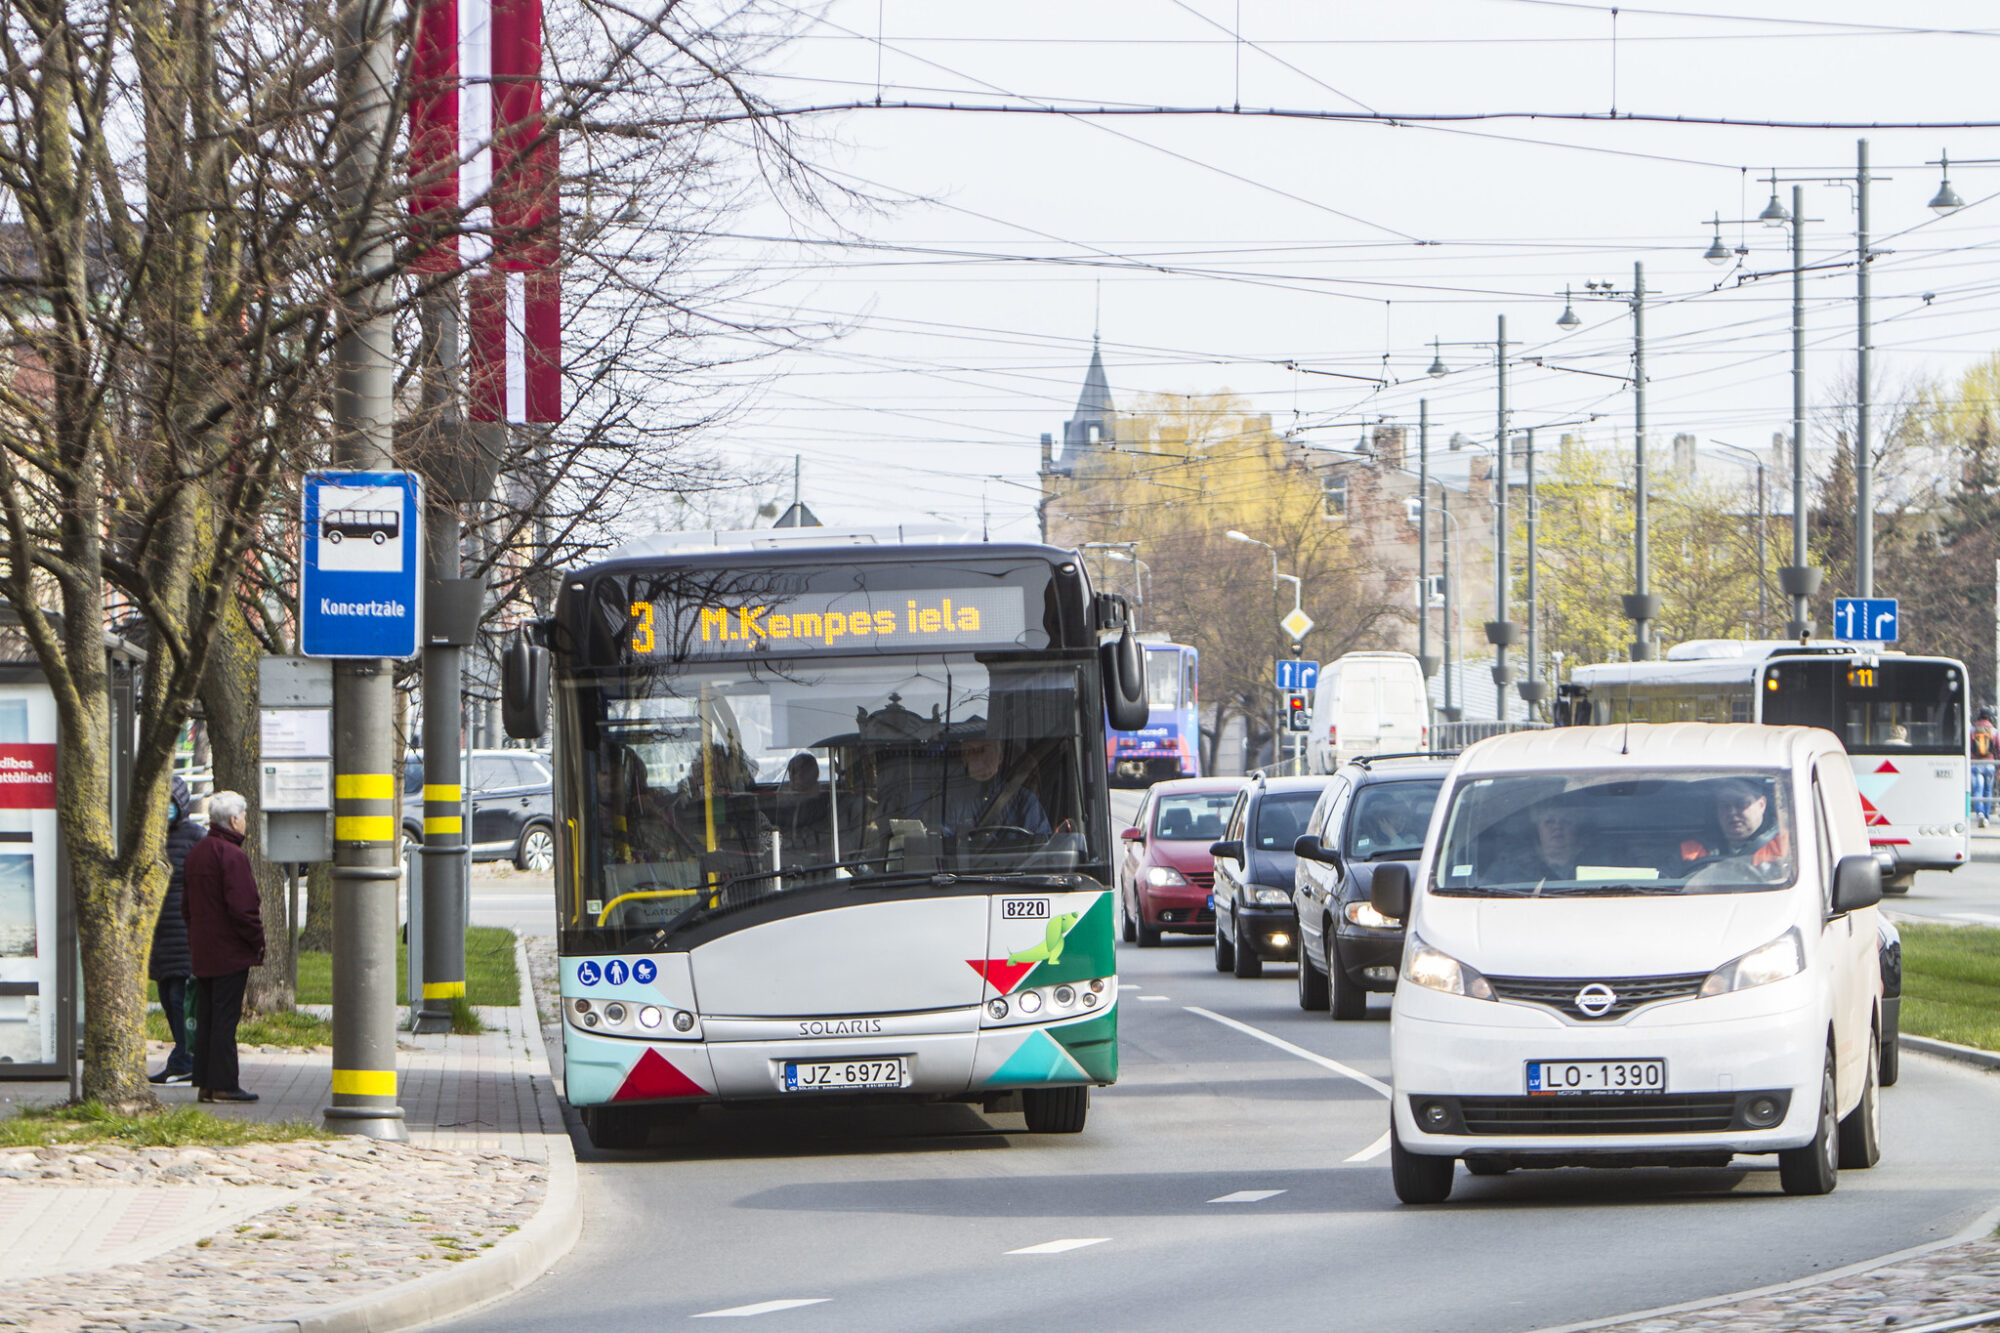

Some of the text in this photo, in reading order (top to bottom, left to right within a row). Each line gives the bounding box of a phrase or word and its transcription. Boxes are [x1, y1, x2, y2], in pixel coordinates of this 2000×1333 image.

[321, 598, 405, 617] Koncertzāle
[630, 601, 654, 653] 3
[701, 598, 979, 649] M.Ķempes iela
[1857, 668, 1873, 687] 11
[1007, 901, 1045, 917] 8220
[799, 1019, 881, 1036] SOLARIS
[787, 1077, 797, 1085] LV
[803, 1063, 896, 1084] JZ-6972
[1528, 1079, 1540, 1087] LV
[1547, 1064, 1659, 1087] LO-1390
